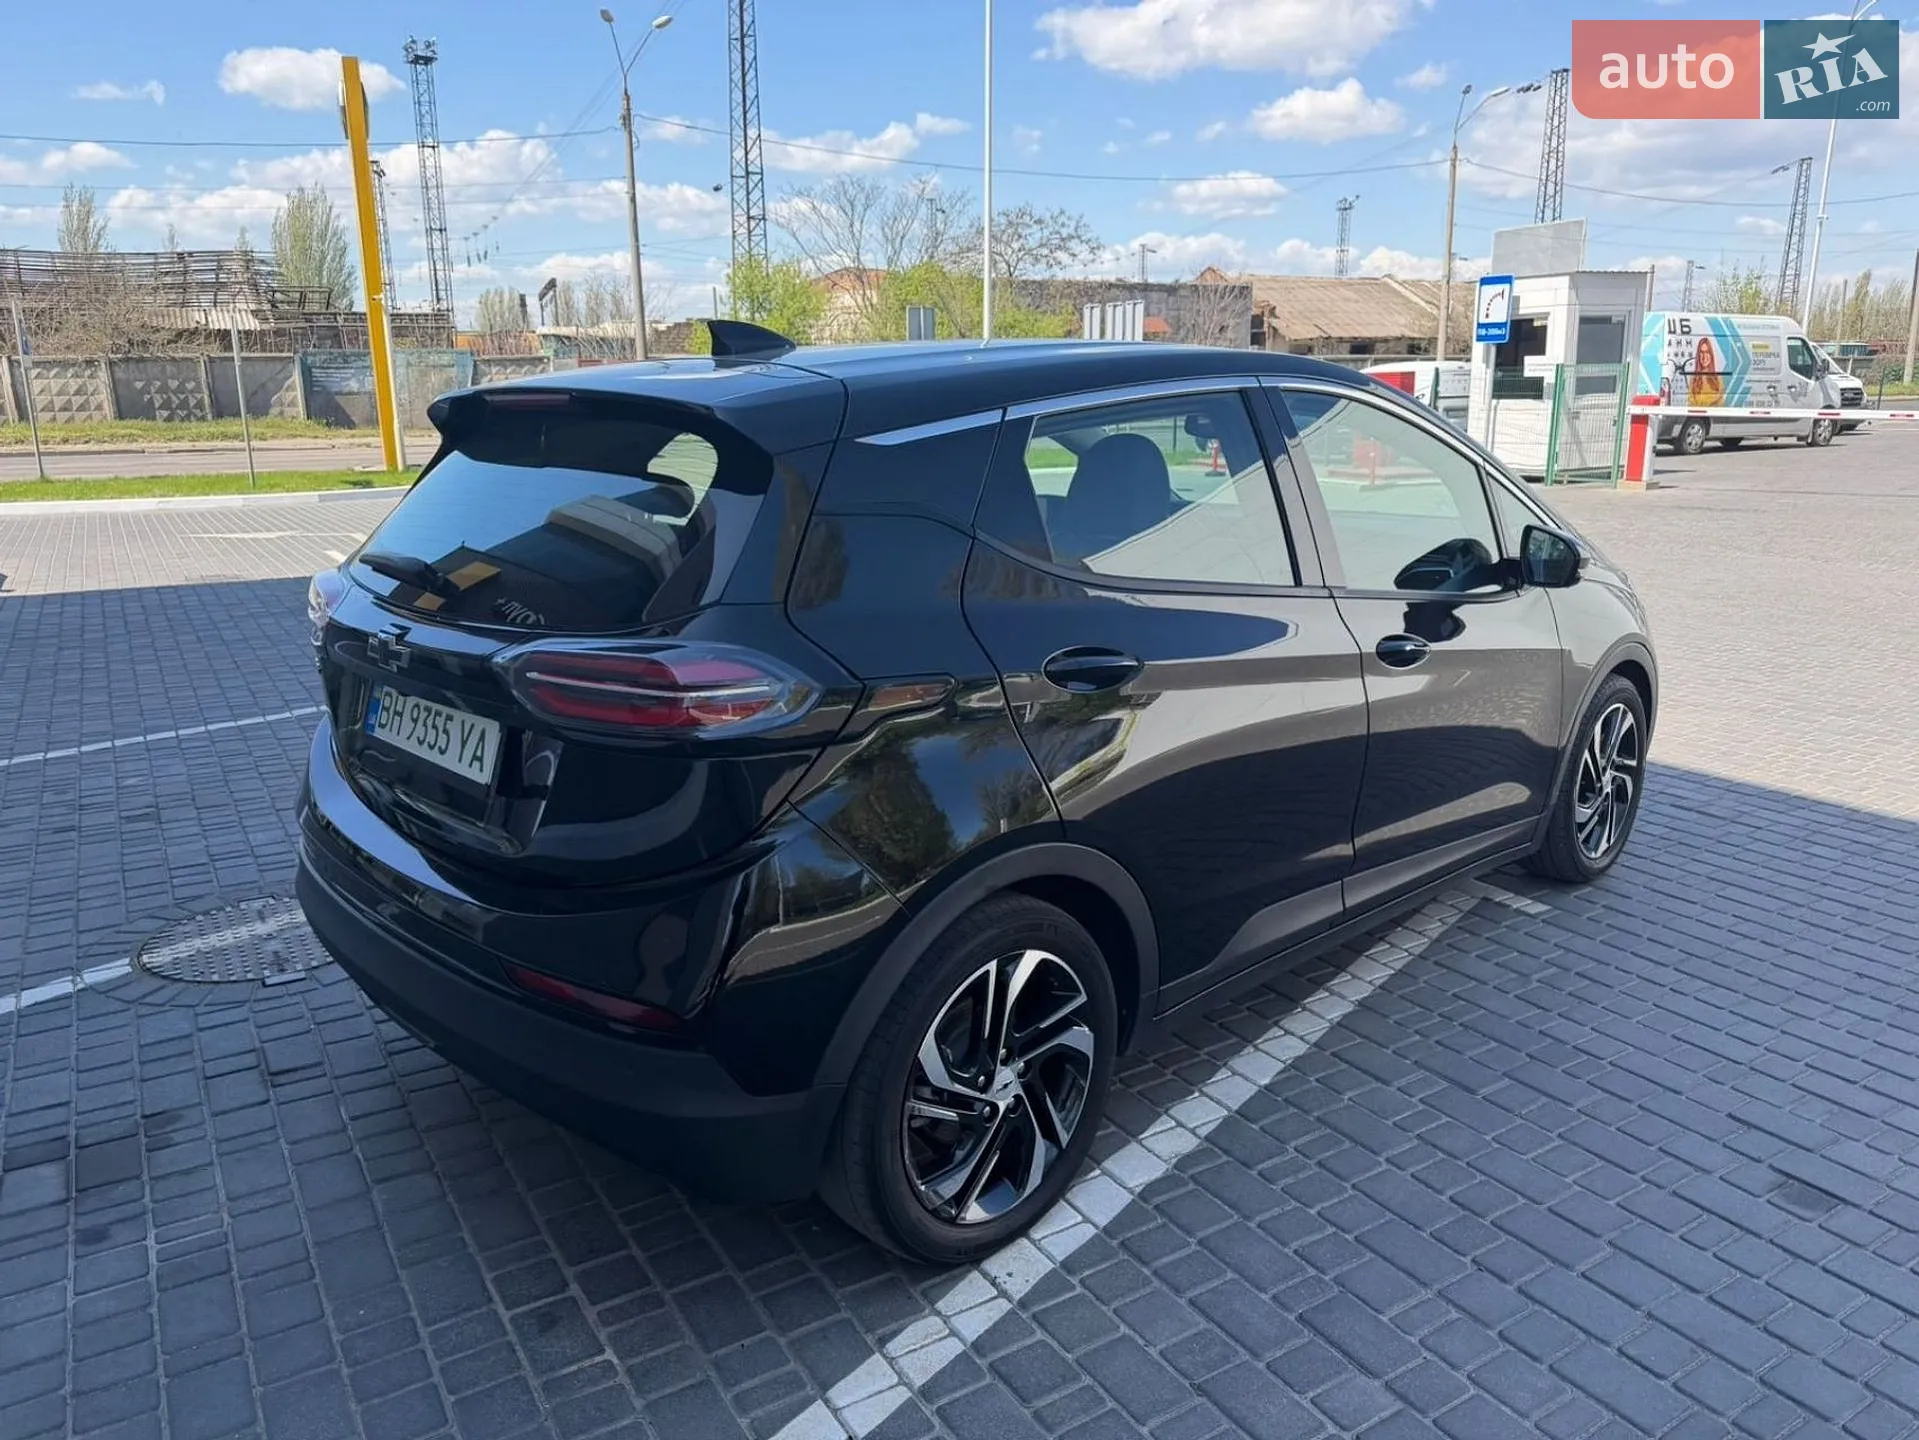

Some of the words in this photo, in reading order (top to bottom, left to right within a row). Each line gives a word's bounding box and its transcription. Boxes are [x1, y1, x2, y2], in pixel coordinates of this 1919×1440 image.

[378, 689, 407, 736] BH
[406, 701, 454, 756] 9355
[458, 719, 487, 773] YA
